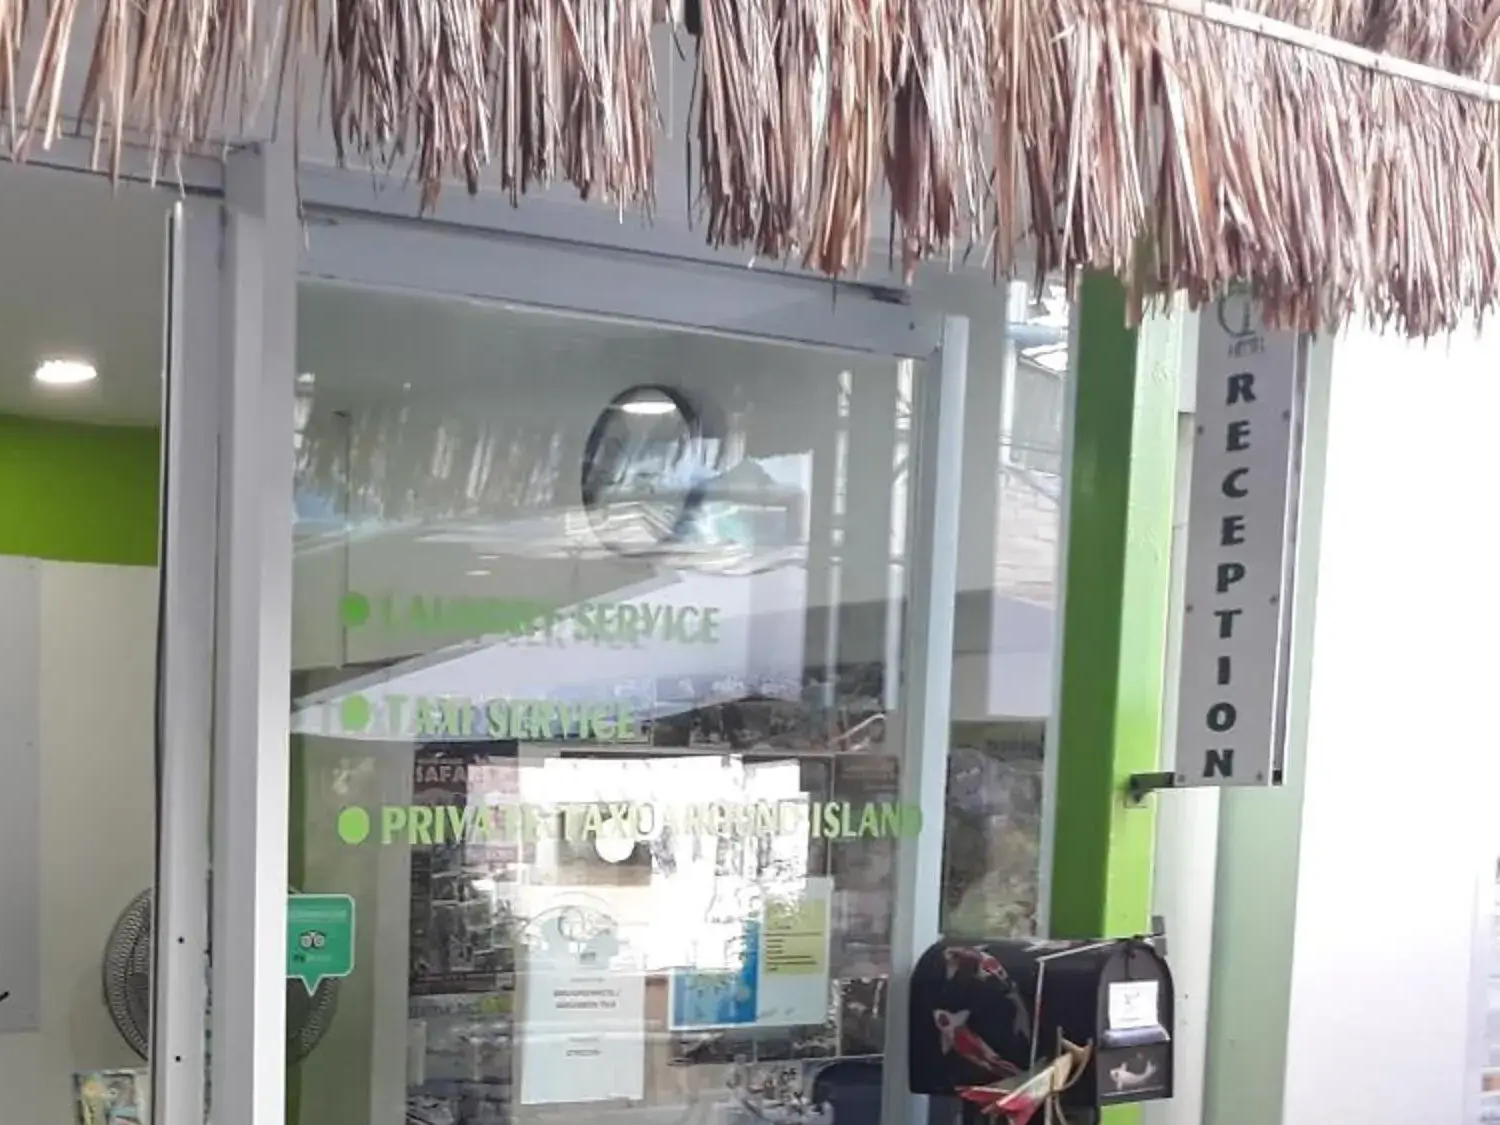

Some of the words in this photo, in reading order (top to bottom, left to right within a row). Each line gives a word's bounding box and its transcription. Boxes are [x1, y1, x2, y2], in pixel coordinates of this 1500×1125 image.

[1202, 372, 1257, 779] RECEPTION
[574, 602, 721, 647] SERVICE
[486, 698, 637, 740] SERVICE
[380, 804, 541, 846] PRIVATE
[810, 802, 923, 839] ISLAND
